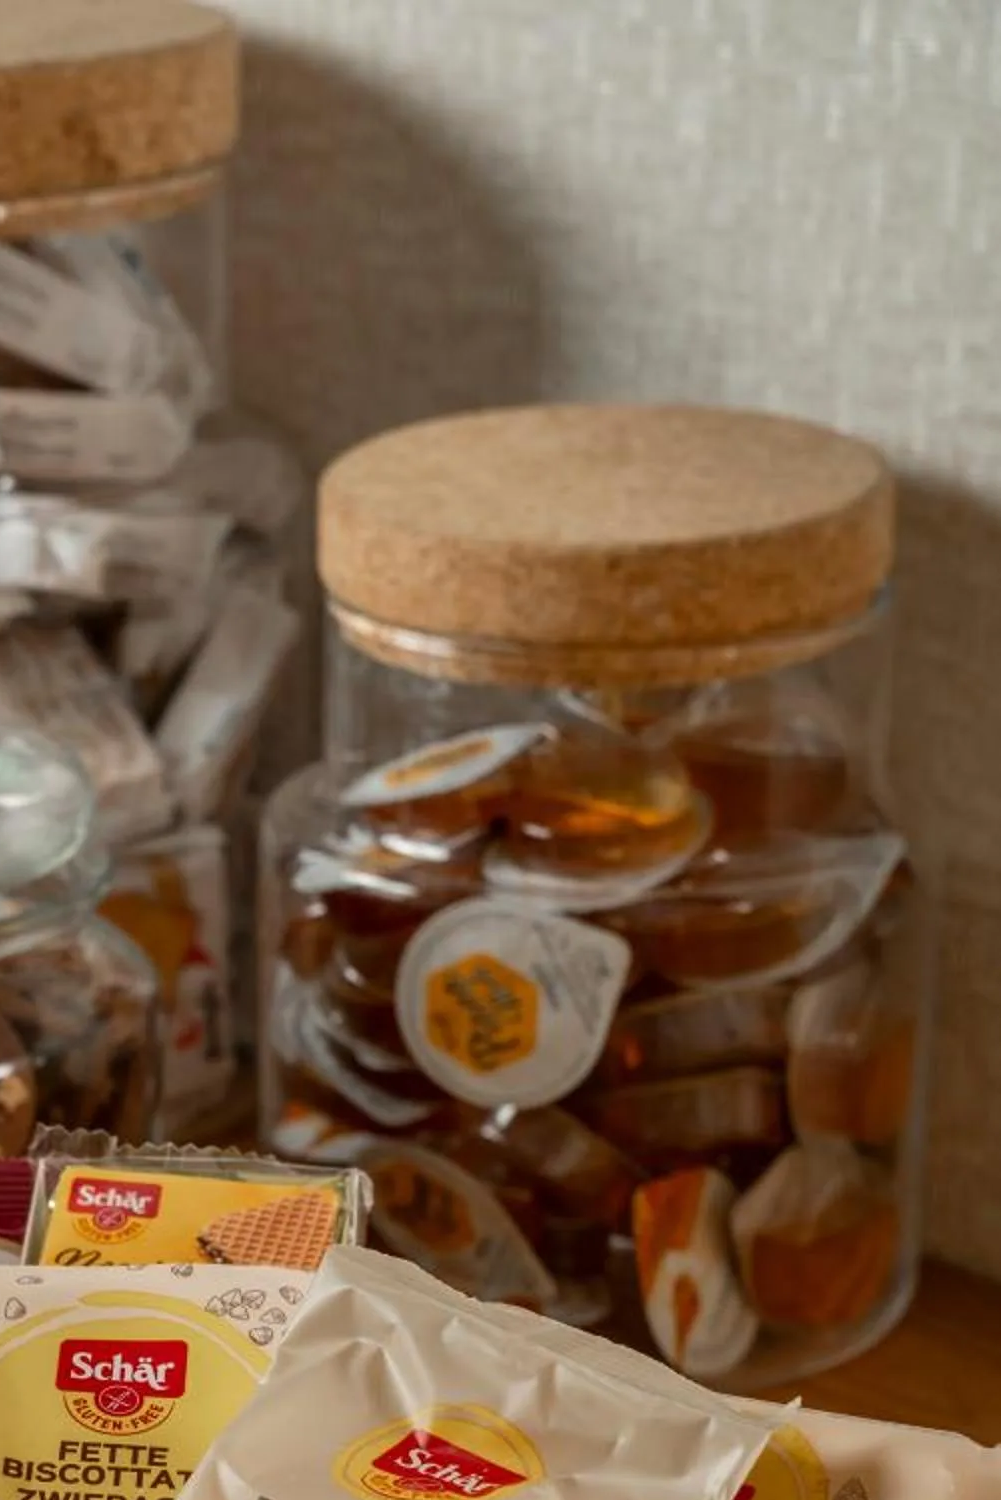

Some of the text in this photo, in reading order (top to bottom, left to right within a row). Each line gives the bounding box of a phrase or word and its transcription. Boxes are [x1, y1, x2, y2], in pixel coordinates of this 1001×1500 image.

[75, 1184, 153, 1215] Schär
[69, 1352, 175, 1391] Schär
[58, 1440, 169, 1467] FETTE
[2, 1456, 195, 1490] BISCOTTAT
[393, 1447, 500, 1496] Schär
